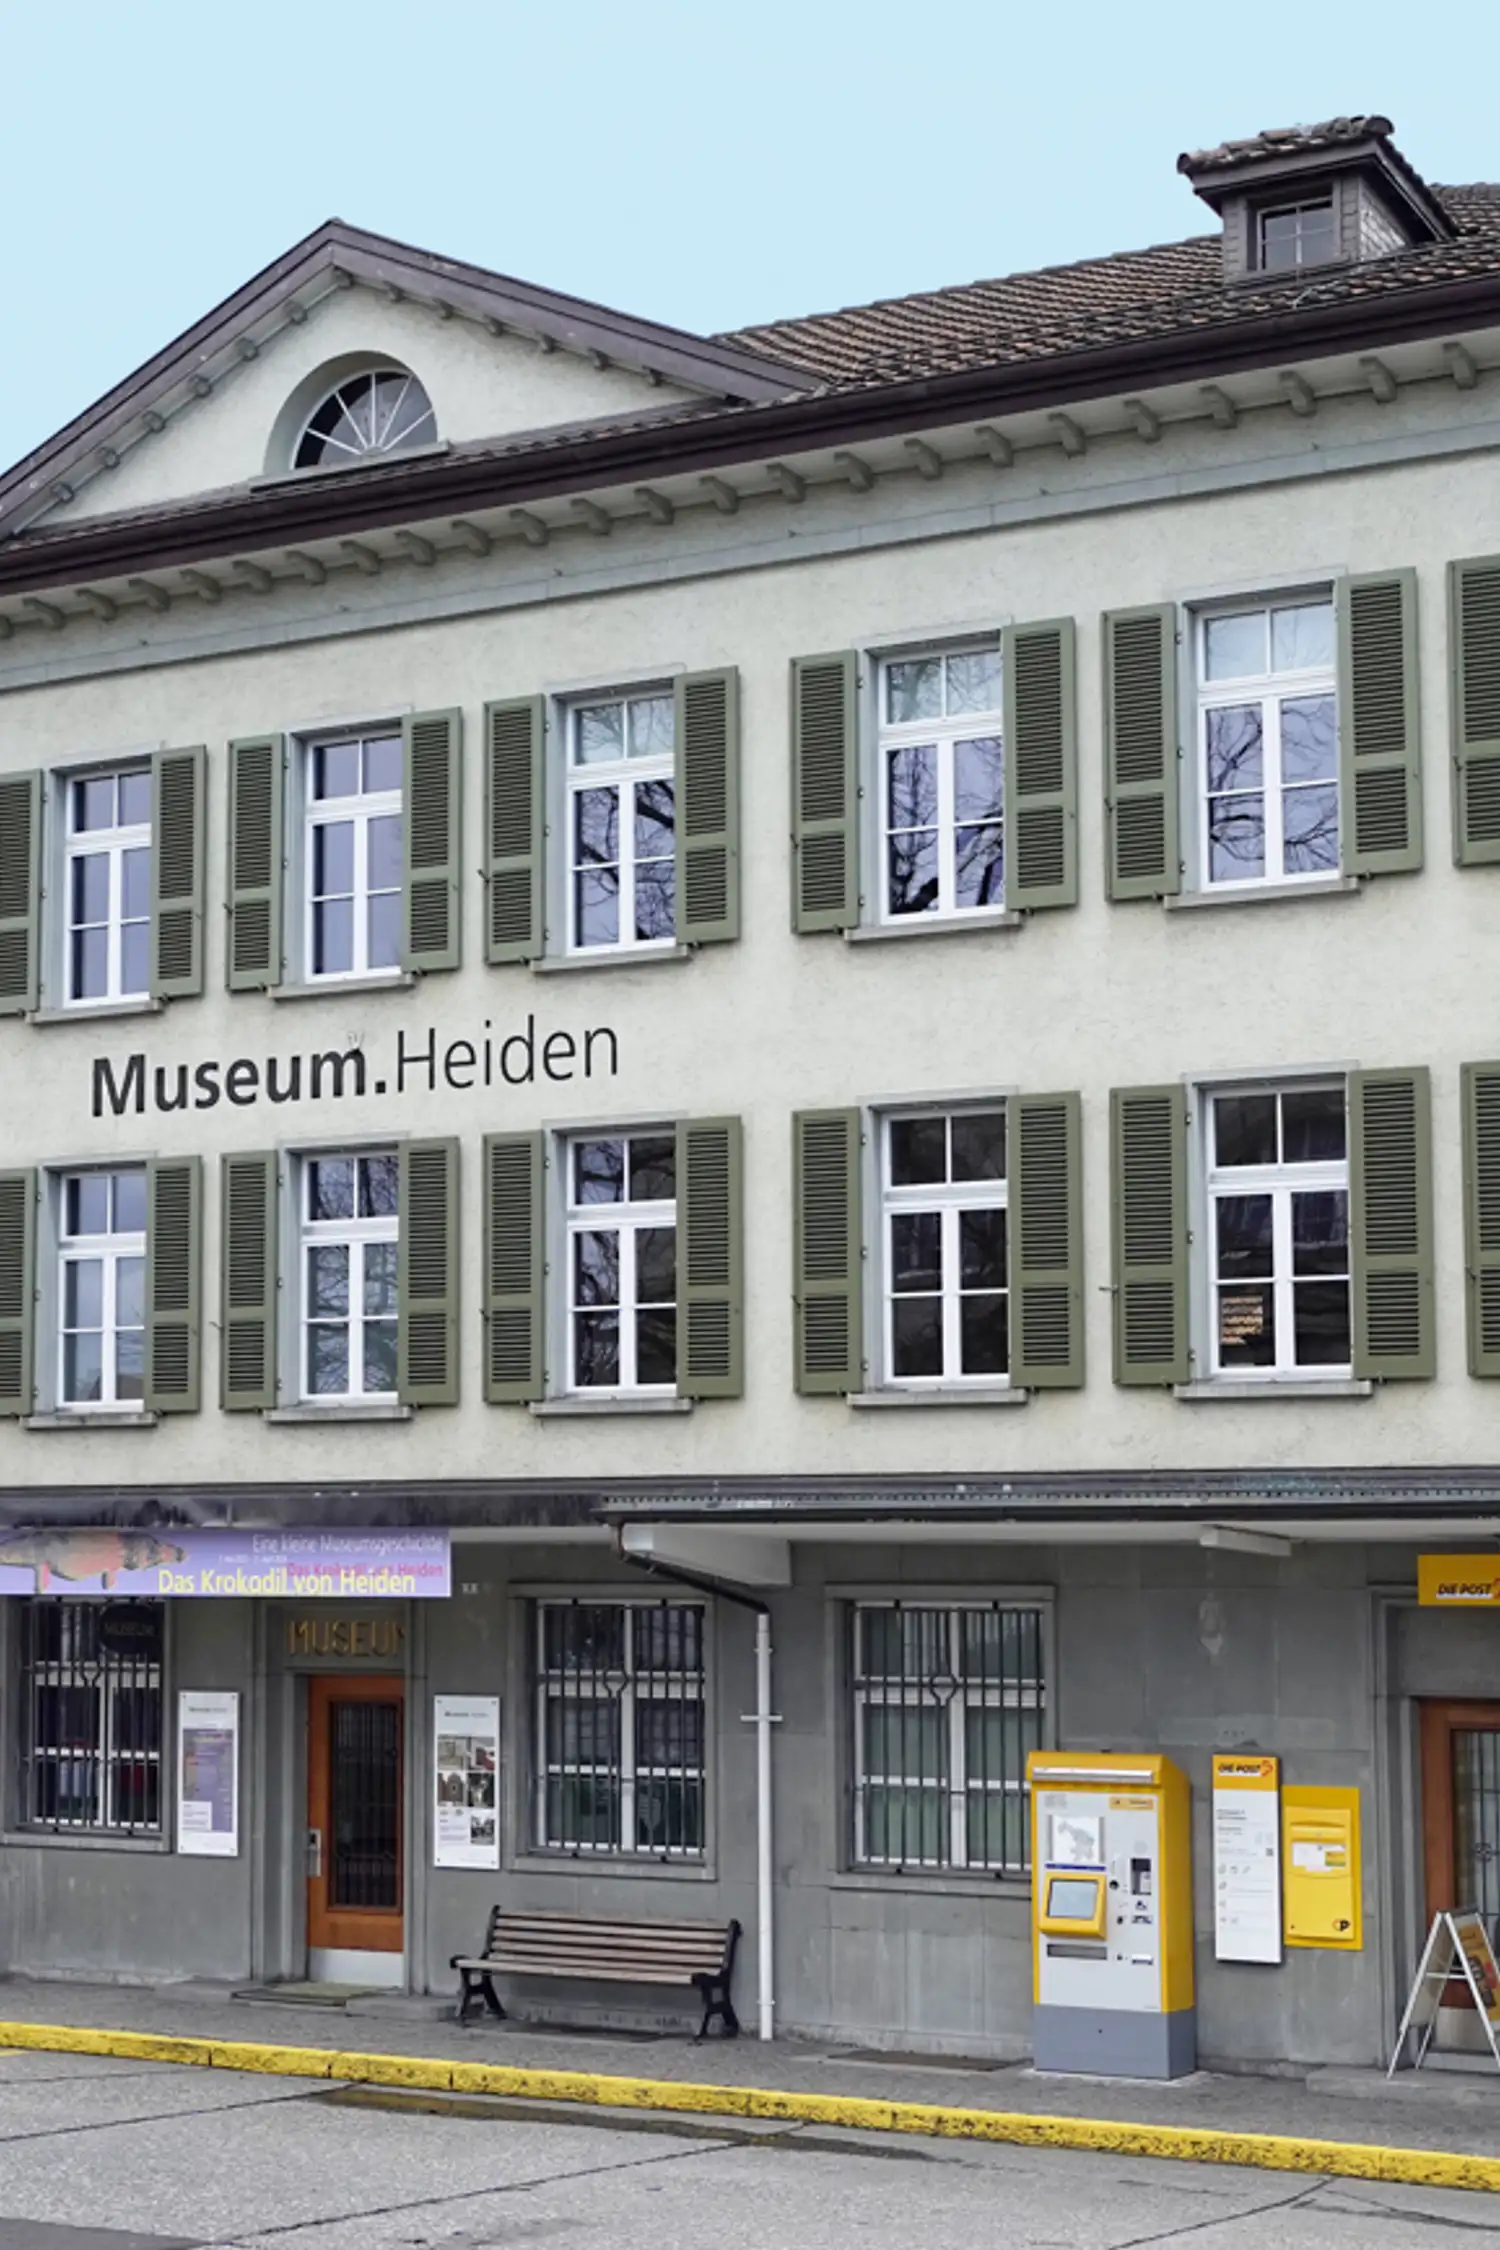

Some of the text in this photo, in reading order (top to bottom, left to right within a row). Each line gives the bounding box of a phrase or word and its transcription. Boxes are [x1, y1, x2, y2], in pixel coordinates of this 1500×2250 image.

[92, 1014, 618, 1117] Museum.Heiden
[158, 1566, 416, 1595] Das Krokodil von Heiden
[1438, 1582, 1492, 1595] DIE POST
